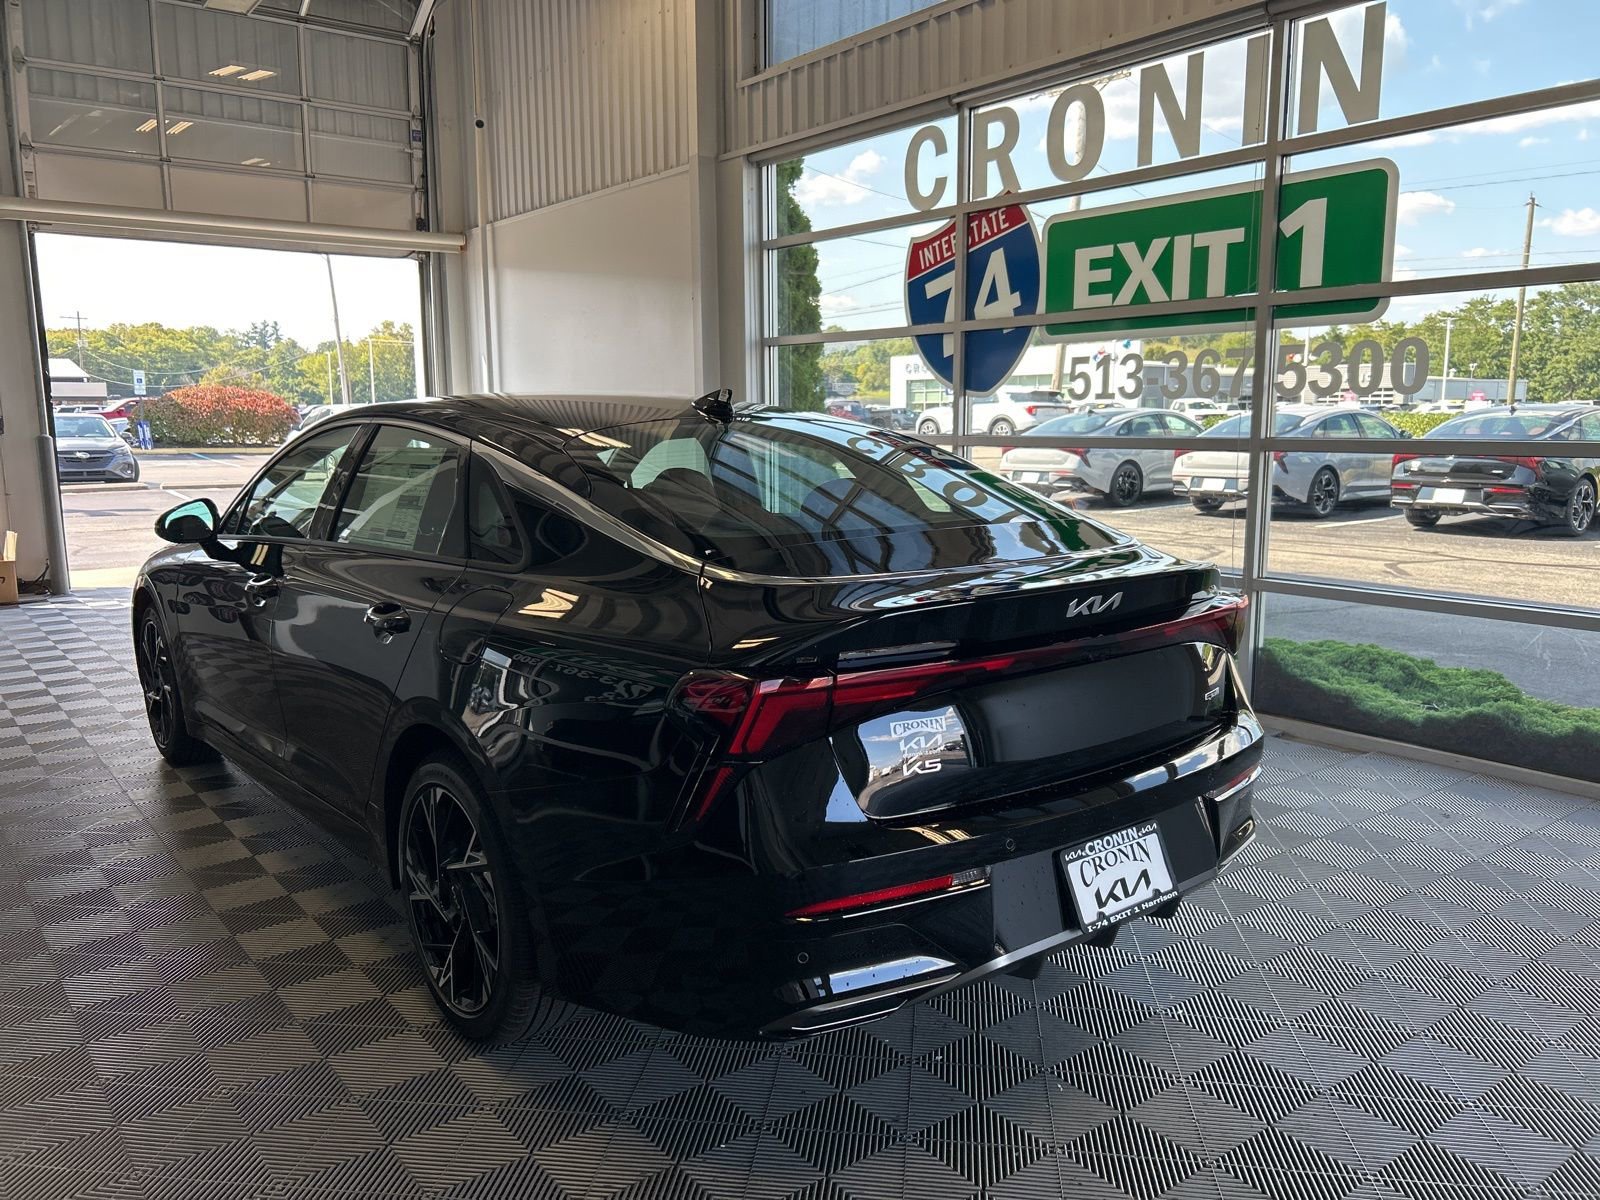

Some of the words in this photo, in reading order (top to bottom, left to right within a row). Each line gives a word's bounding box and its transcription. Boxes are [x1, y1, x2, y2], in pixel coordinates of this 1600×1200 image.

[905, 3, 1386, 211] CRONIN
[918, 207, 1010, 270] INTERTATE
[1073, 228, 1245, 310] EXIT
[1279, 198, 1328, 288] 1
[925, 247, 1021, 359] 74
[892, 717, 944, 736] CRONIN
[902, 757, 942, 777] K5
[1080, 838, 1153, 888] CRONIN
[1085, 826, 1139, 856] CRONIN
[1087, 919, 1109, 933] I-74
[1109, 909, 1132, 924] EXIT
[1141, 890, 1179, 910] Harrison
